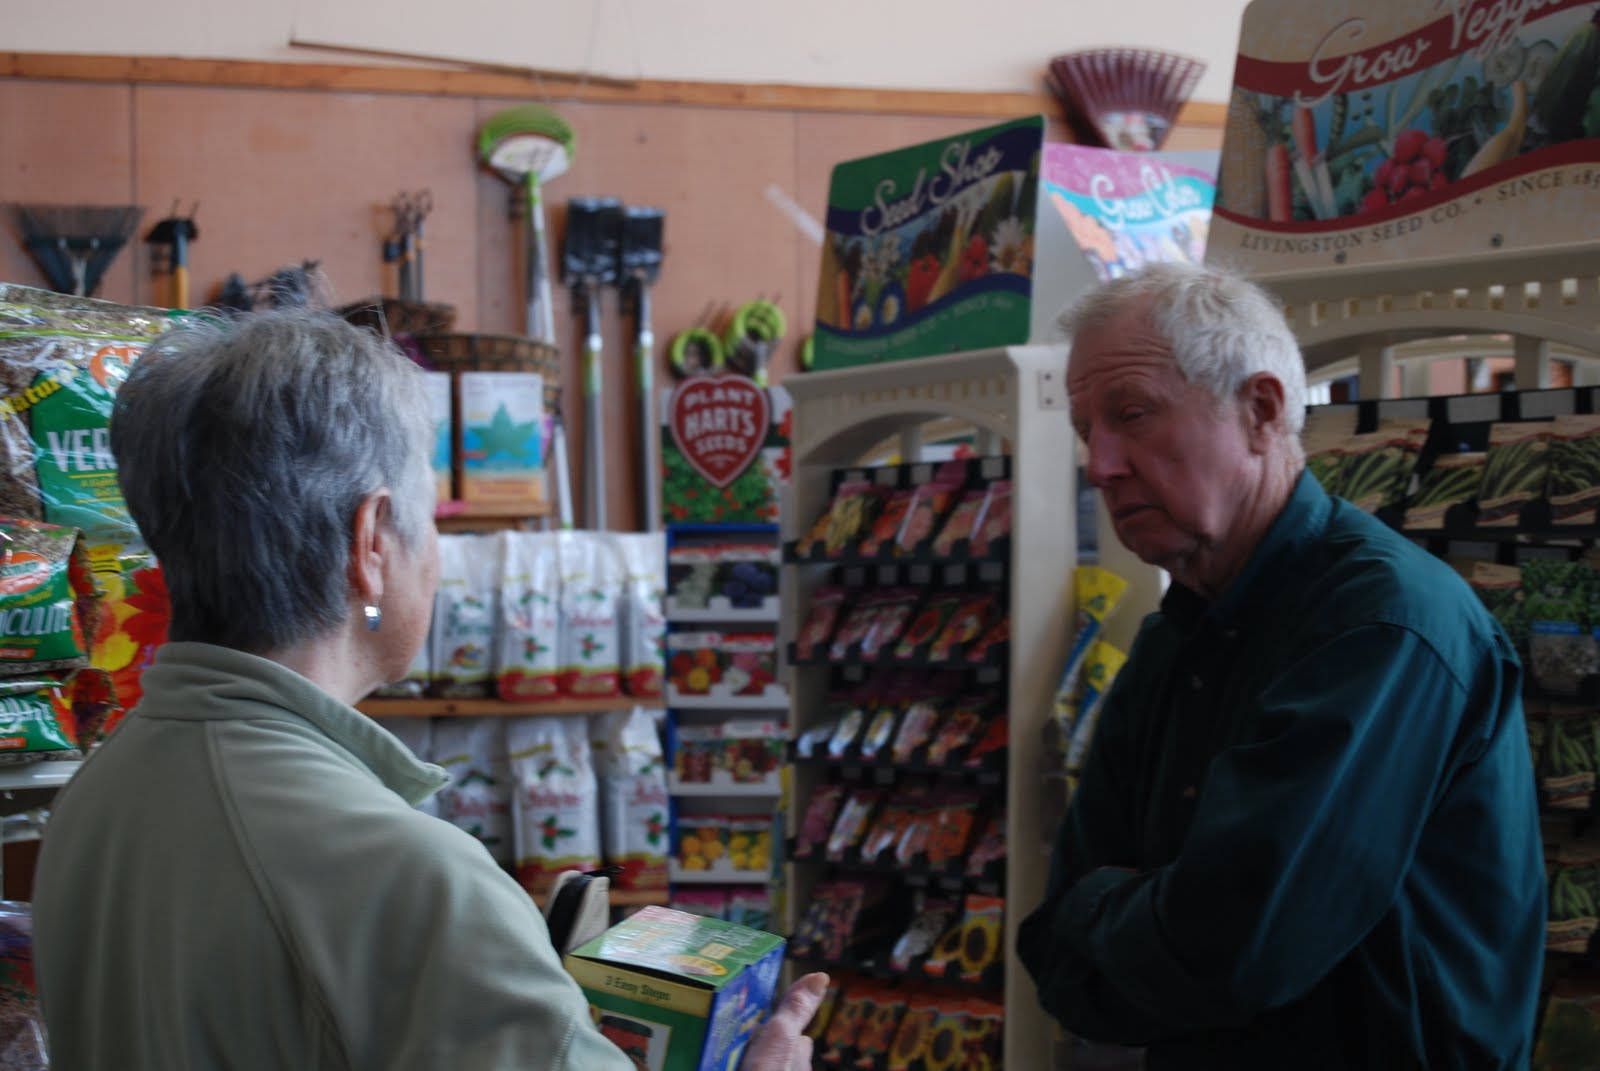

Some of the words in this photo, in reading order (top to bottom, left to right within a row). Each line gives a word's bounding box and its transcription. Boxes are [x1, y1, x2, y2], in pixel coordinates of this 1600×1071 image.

[1294, 17, 1432, 109] Grow
[860, 168, 928, 236] Seed
[929, 141, 1005, 206] Shop
[1241, 230, 1362, 255] LIVINGSTON
[1371, 215, 1423, 243] SEED
[1496, 171, 1565, 201] SINCE
[684, 387, 756, 409] PLANT
[695, 435, 747, 456] SEEDS
